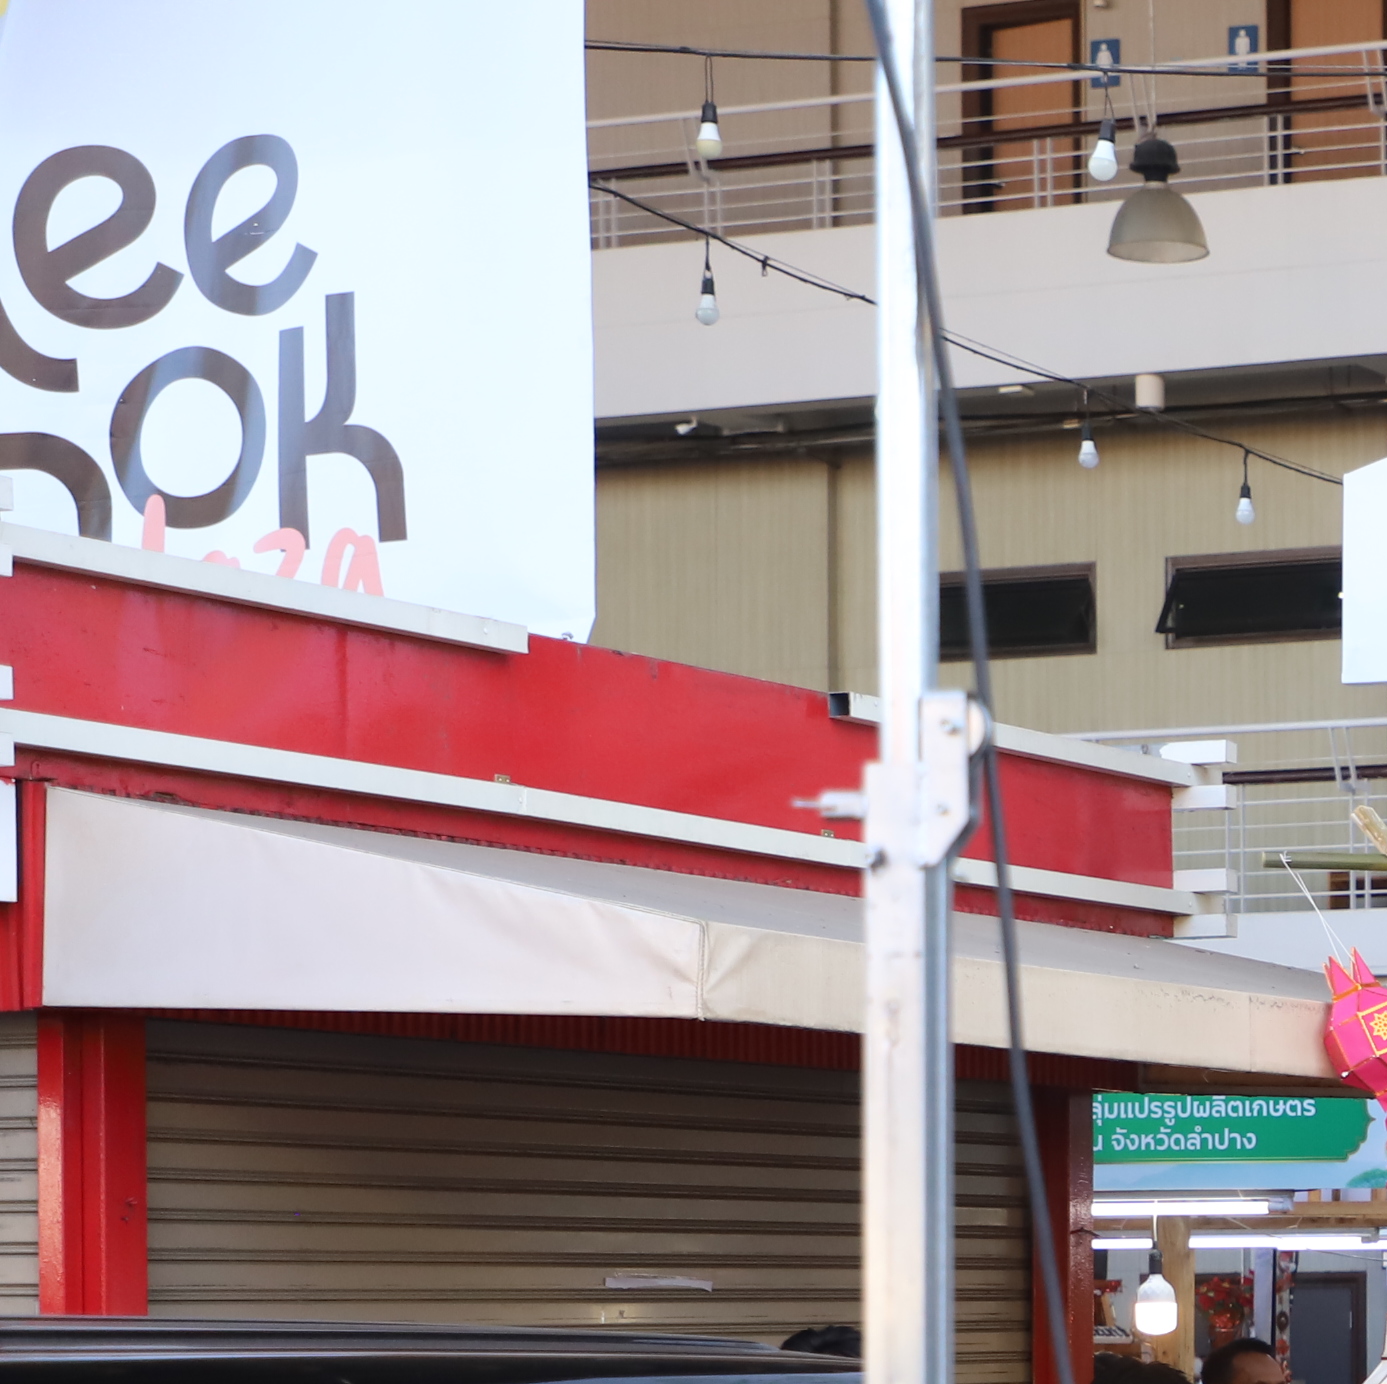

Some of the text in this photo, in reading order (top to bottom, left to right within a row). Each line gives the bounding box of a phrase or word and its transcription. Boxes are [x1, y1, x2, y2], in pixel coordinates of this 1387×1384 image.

[1111, 1126, 1257, 1150] จังหวัดลำปาง
